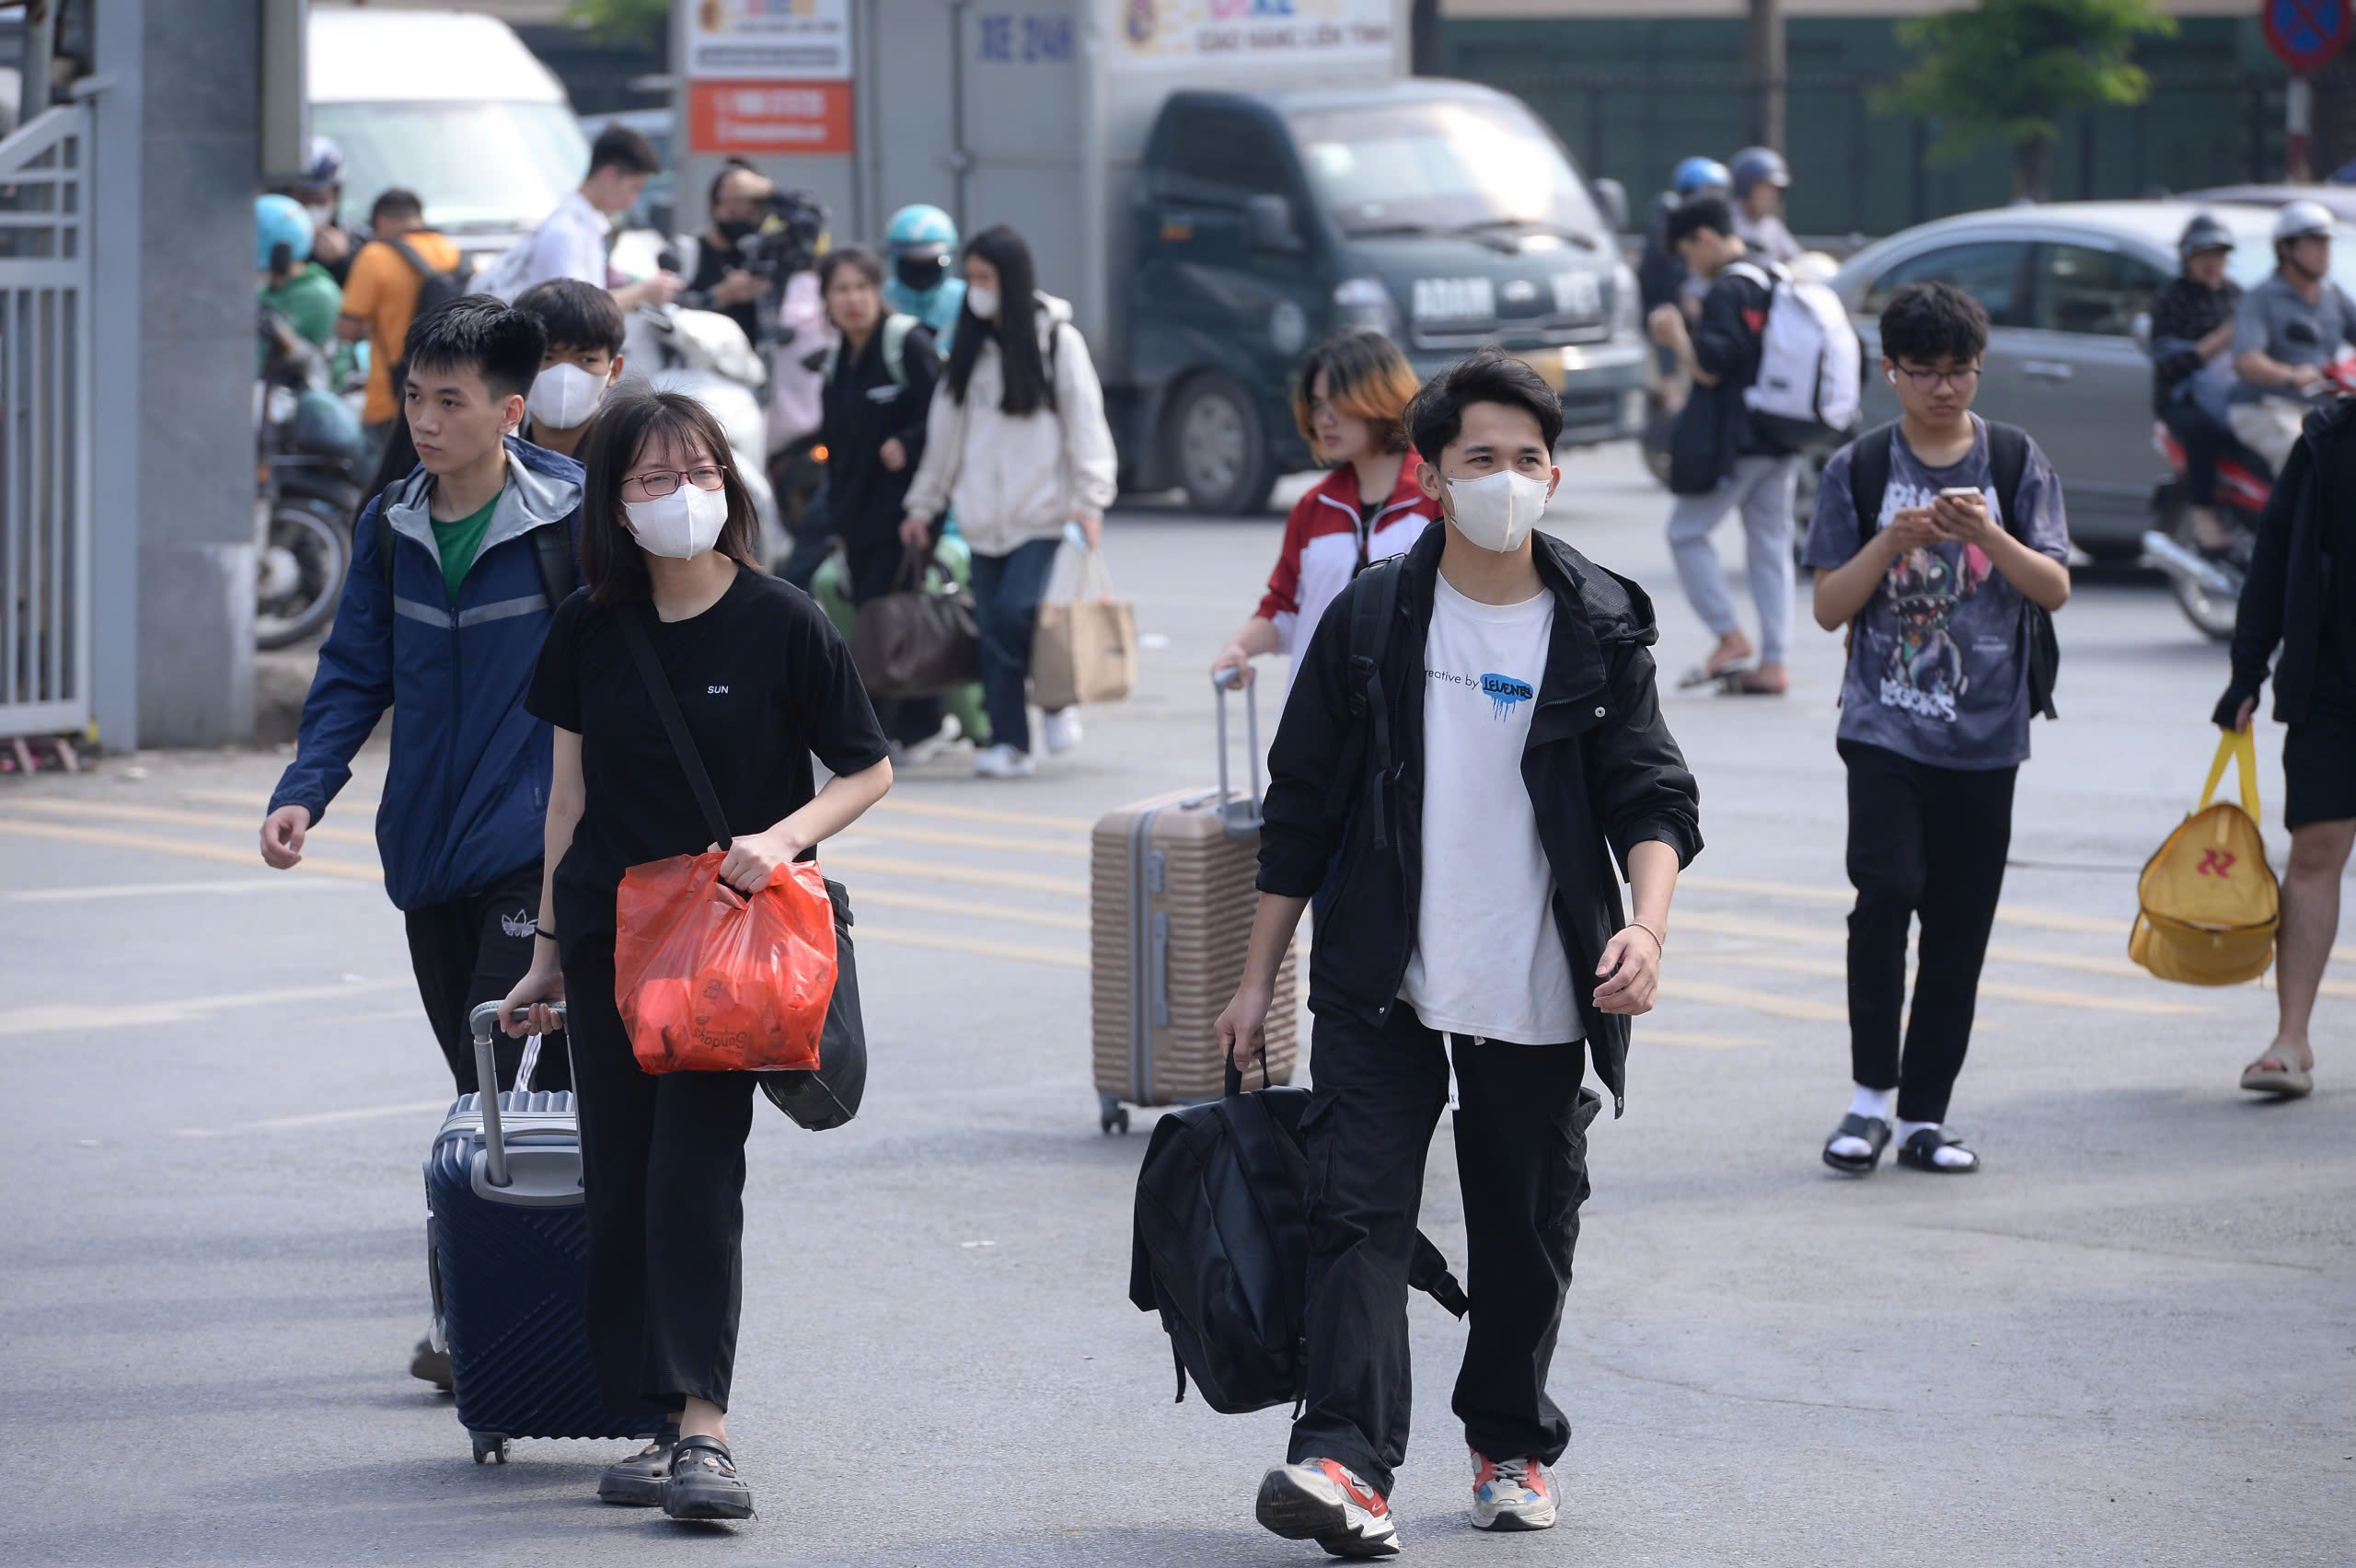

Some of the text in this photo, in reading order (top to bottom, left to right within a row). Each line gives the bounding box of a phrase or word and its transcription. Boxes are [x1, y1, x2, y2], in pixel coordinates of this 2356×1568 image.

[707, 685, 729, 695] SUN
[1424, 669, 1461, 684] reative
[1464, 673, 1480, 691] by
[692, 1028, 747, 1052] Sundays
